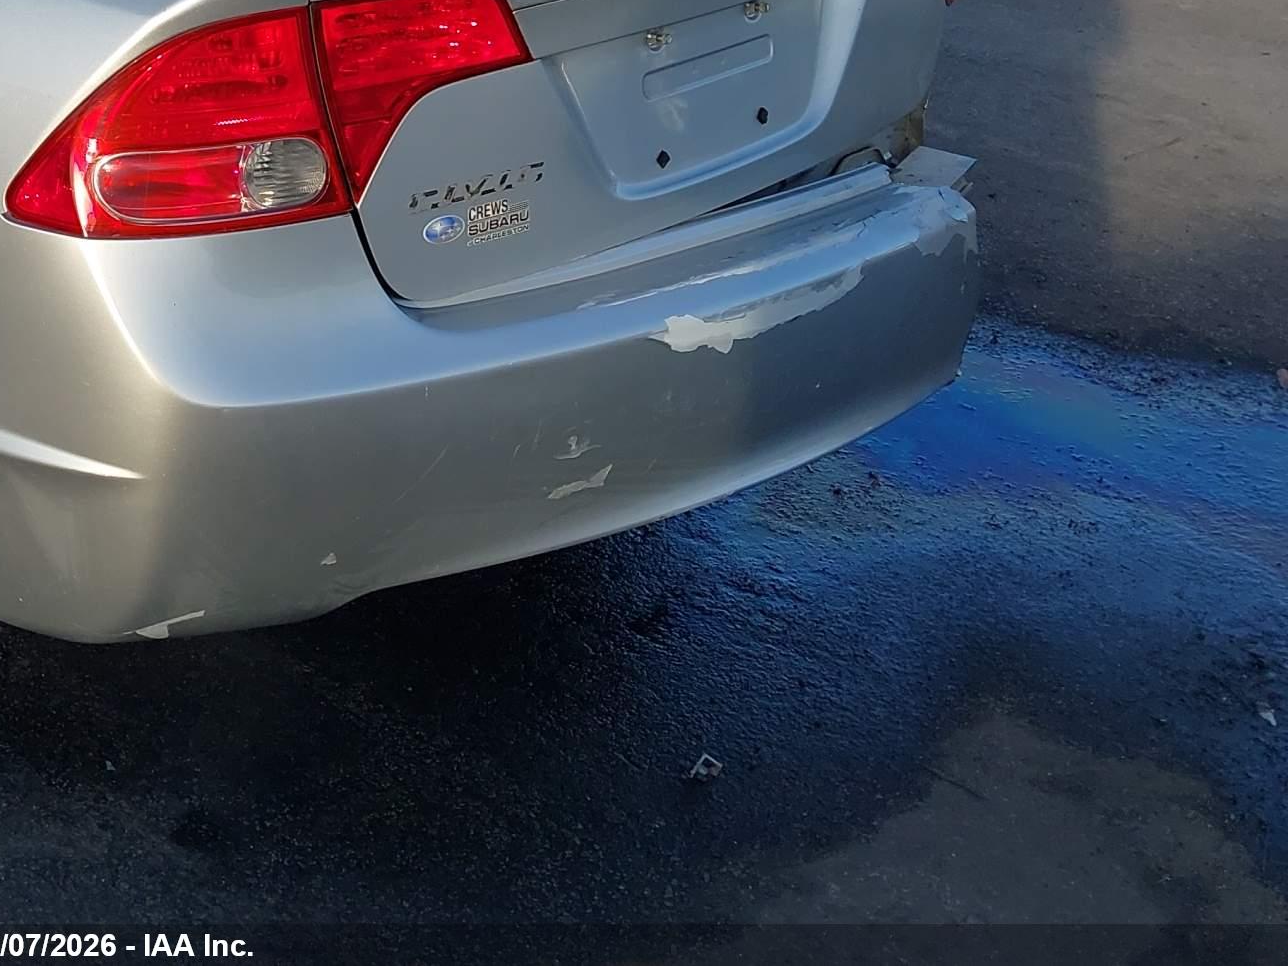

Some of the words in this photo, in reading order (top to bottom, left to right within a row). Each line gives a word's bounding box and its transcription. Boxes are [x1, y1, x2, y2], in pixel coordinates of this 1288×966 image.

[468, 199, 509, 222] CREWS
[468, 210, 530, 236] SUBARU
[473, 224, 530, 245] CHARLESTON
